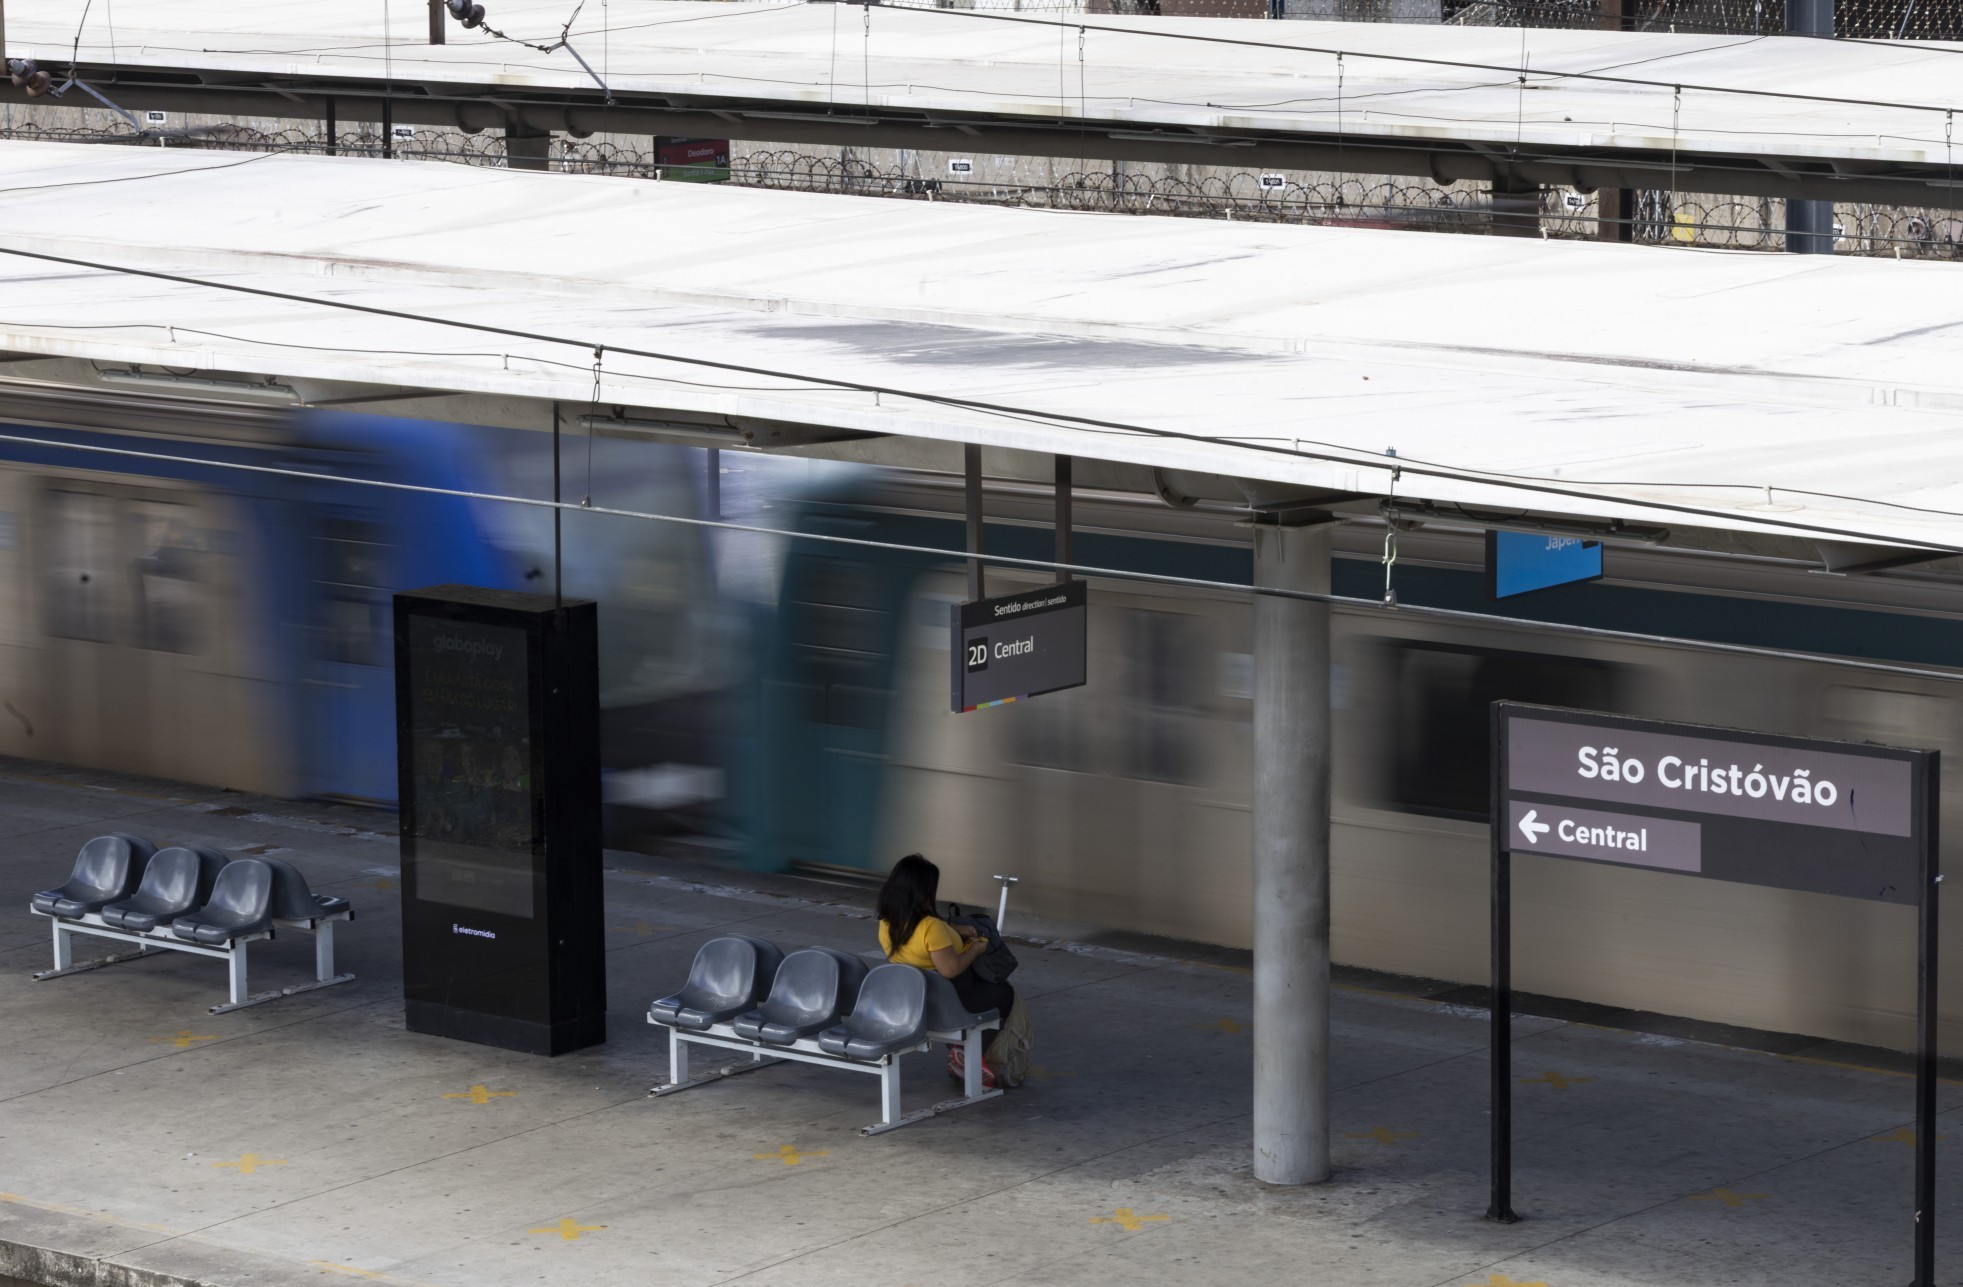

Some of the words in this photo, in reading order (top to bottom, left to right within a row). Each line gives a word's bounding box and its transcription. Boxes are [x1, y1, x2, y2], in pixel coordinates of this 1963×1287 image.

[687, 147, 714, 158] Deodoro
[716, 155, 726, 165] 1A
[994, 602, 1022, 616] Sentido
[1022, 599, 1045, 611] direction
[1047, 595, 1067, 606] sentido
[433, 633, 503, 661] globoplay
[968, 644, 987, 666] 2D
[994, 635, 1034, 659] Central
[1577, 746, 1645, 784] São
[1657, 755, 1838, 807] Cristóvão
[1557, 819, 1647, 852] Central
